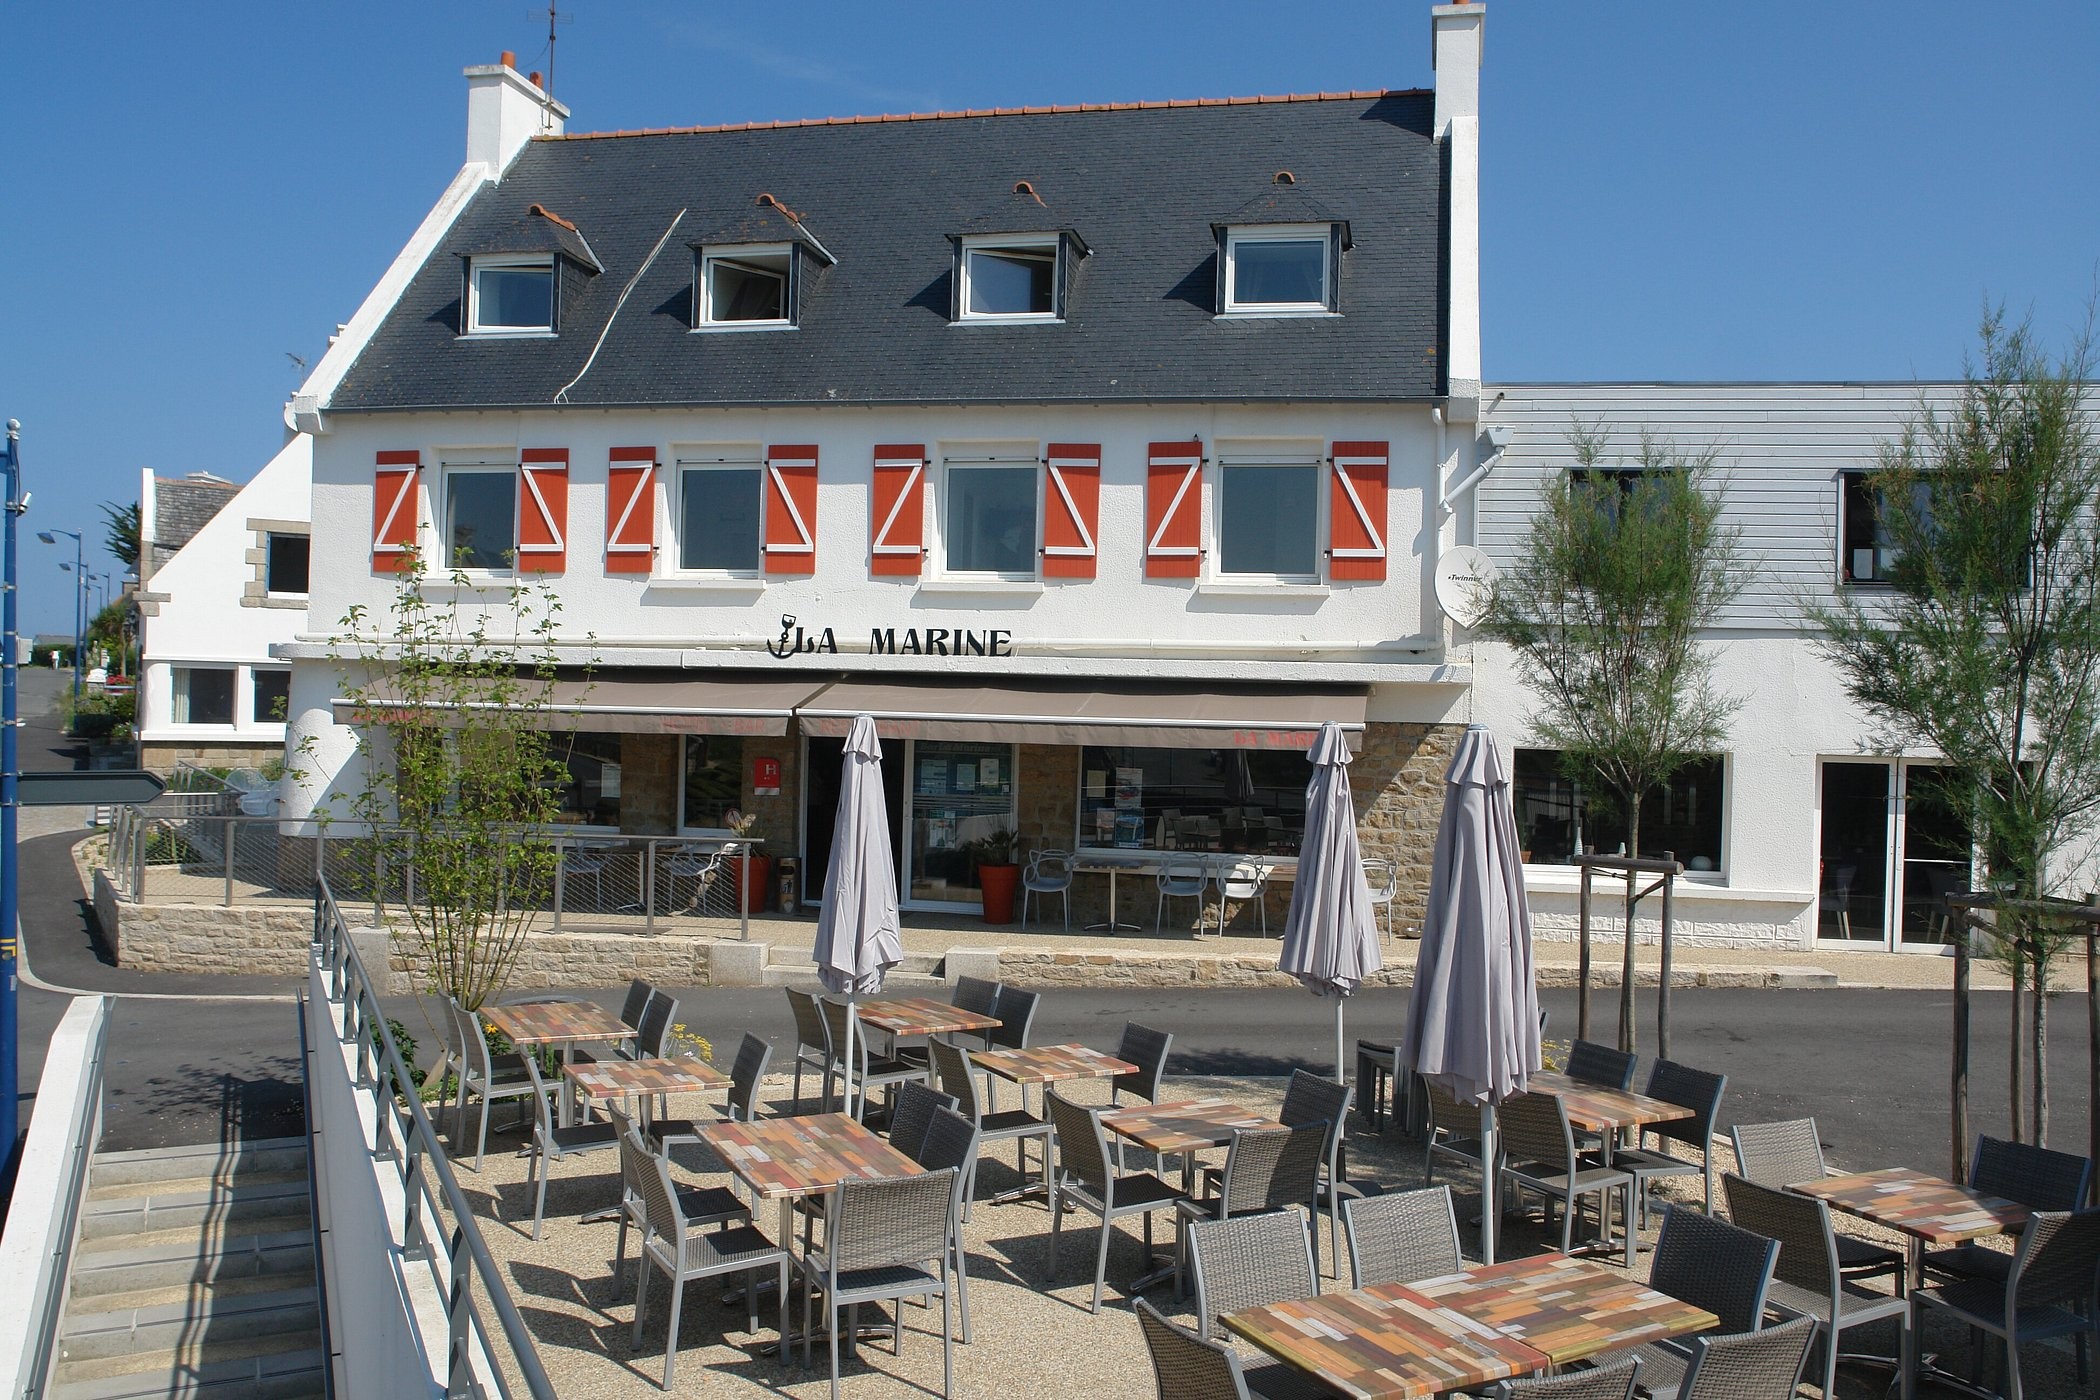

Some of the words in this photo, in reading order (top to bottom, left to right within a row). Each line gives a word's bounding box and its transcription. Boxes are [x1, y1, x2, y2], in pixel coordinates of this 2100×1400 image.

[793, 627, 838, 654] LA
[868, 628, 1013, 657] MARINE
[733, 718, 765, 733] BAR
[1234, 730, 1258, 747] LA
[1265, 730, 1319, 749] MARI
[765, 764, 777, 775] H
